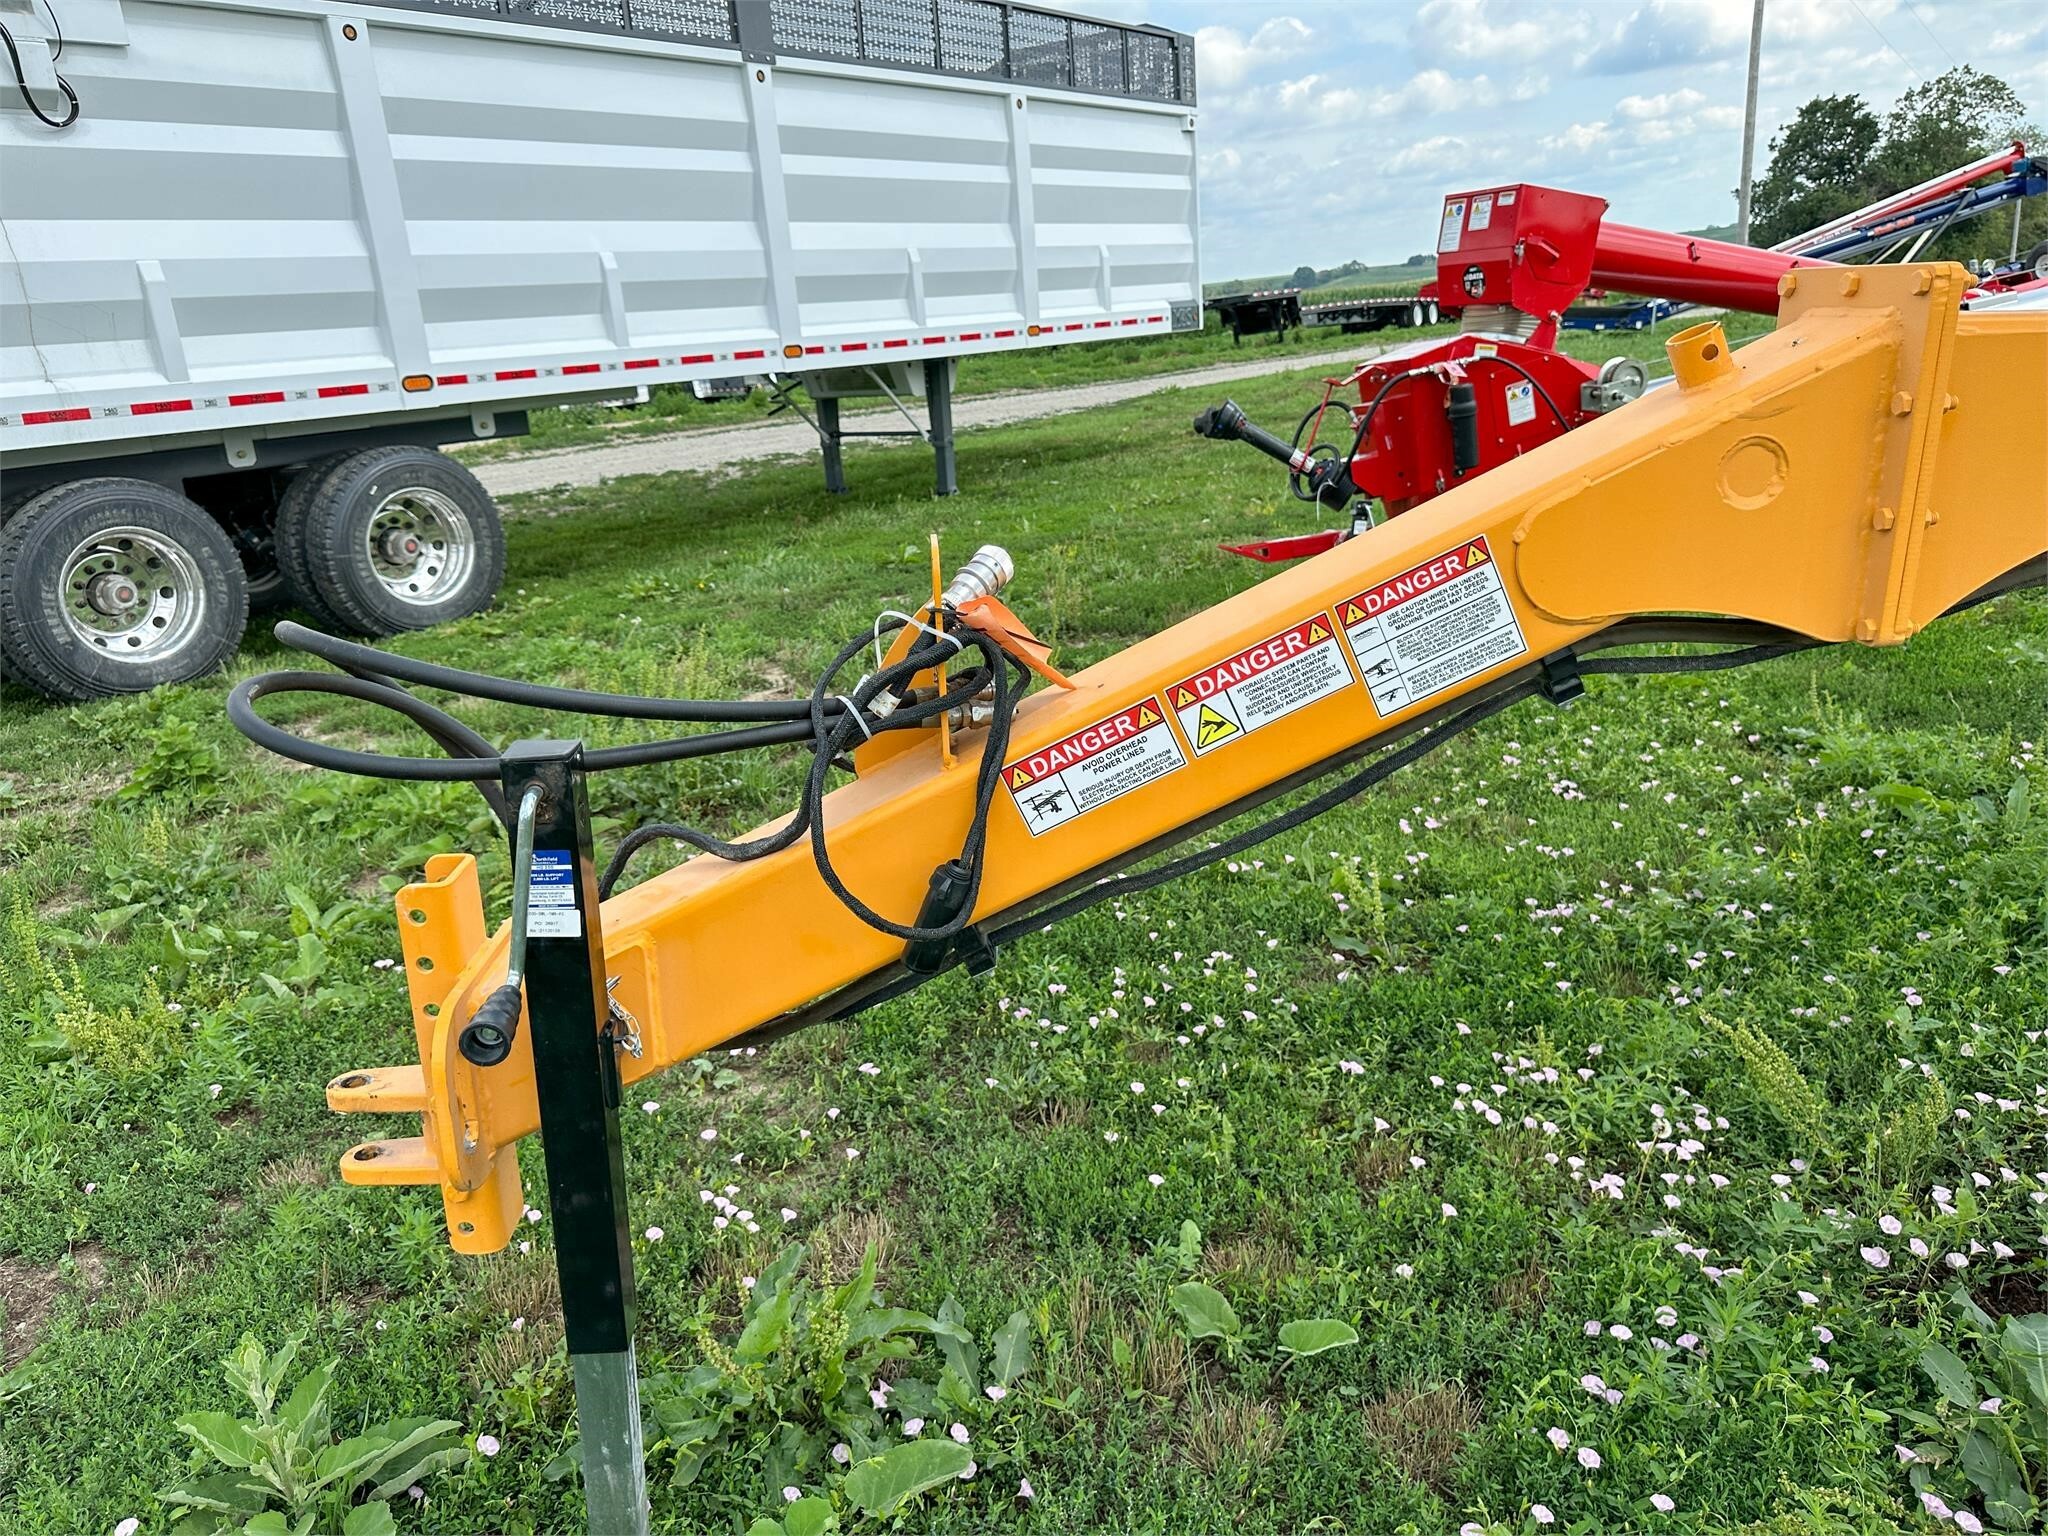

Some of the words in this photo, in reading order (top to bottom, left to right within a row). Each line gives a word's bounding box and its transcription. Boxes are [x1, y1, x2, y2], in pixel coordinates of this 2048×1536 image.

[1364, 554, 1462, 612] DANGER
[1386, 610, 1400, 620] USE
[1400, 597, 1428, 614] CAUTION
[1429, 587, 1448, 600] WHEN
[1448, 582, 1458, 591] ON
[1459, 570, 1484, 586] UNEVEN
[1395, 614, 1423, 631] MACHINE
[1424, 602, 1449, 617] TIPPING
[1449, 595, 1463, 605] MAY
[1463, 583, 1488, 598] OCCUR.
[1387, 610, 1414, 627] GROUND
[1415, 605, 1425, 614] OR
[1425, 595, 1446, 609] GOING
[1446, 588, 1463, 599] FAST
[1396, 633, 1413, 644] BLOCK
[1430, 615, 1452, 628] SUPPORT
[1453, 606, 1471, 617] RAISED
[1471, 595, 1493, 608] MACHINE
[1397, 640, 1422, 654] CRUSHING
[1423, 631, 1440, 642] INJURY
[1449, 620, 1464, 630] DEATH
[1465, 613, 1479, 622] FROM
[1480, 603, 1500, 615] SUDDEN
[1416, 629, 1433, 640] LIFTED
[1434, 613, 1467, 631] COMPONENTS
[1475, 598, 1498, 612] PREVENT
[1399, 644, 1424, 659] DROPPING
[1433, 625, 1466, 643] INADVERTENT
[1466, 611, 1494, 627] OPERATION
[1409, 644, 1436, 659] CONTROLS
[1436, 637, 1451, 647] WHILE
[1452, 622, 1484, 639] PERFORMING
[1484, 616, 1495, 624] AND
[1417, 643, 1451, 661] MAINTENANCE
[1194, 630, 1305, 696] DANGER
[1237, 674, 1271, 693] HYDRAULIC
[1271, 662, 1295, 677] SYSTEM
[1296, 652, 1315, 665] PARTS
[1316, 645, 1330, 655] AND
[1244, 673, 1286, 697] CONNECTIONS
[1287, 667, 1300, 676] CAN
[1300, 654, 1327, 670] CONTAIN
[1249, 691, 1264, 702] HIGH
[1264, 674, 1300, 694] PRESSURES
[1300, 664, 1321, 677] WHICH
[1407, 669, 1428, 681] BEFORE
[1429, 655, 1457, 671] CHANGING
[1457, 648, 1472, 658] RAKE
[1473, 642, 1485, 651] ARM
[1411, 679, 1430, 690] CLEAR
[1438, 670, 1449, 678] ALL
[1449, 654, 1484, 672] BYSTANDERS
[1484, 648, 1496, 656] AND
[1496, 639, 1515, 650] OTHER
[1411, 681, 1437, 696] POSSIBLE
[1438, 669, 1462, 683] OBJECTS
[1463, 657, 1487, 672] SUBJECT
[1496, 642, 1519, 656] DAMAGE
[1412, 675, 1427, 685] MAKE
[1427, 668, 1442, 677] SURE
[1443, 661, 1457, 670] AREA
[1466, 651, 1478, 659] NEW
[1479, 639, 1504, 653] POSITION
[1245, 692, 1276, 710] SUDDENLY
[1276, 686, 1290, 695] AND
[1290, 664, 1336, 689] UNEXPECTEDLY
[1246, 698, 1279, 717] RELEASED,
[1279, 691, 1292, 701] CAN
[1293, 681, 1313, 695] CAUSE
[1314, 668, 1340, 684] SERIOUS
[1263, 703, 1284, 716] INJURY
[1284, 691, 1308, 705] AND/OR
[1028, 713, 1136, 777] DANGER
[1081, 756, 1104, 771] AVOID
[1105, 735, 1148, 760] OVERHEAD
[1093, 757, 1121, 775] POWER
[1122, 746, 1145, 761] LINES
[1078, 780, 1103, 796] SERIOUS
[1103, 770, 1124, 783] INJURY
[1134, 757, 1153, 769] DEATH
[1154, 748, 1171, 759] FROM
[1078, 794, 1104, 809] WITHOUT
[1105, 776, 1142, 796] CONTACTING
[1142, 765, 1164, 779] POWER
[1164, 757, 1181, 768] LINES
[1081, 781, 1116, 801] ELECTRICAL
[1117, 772, 1137, 784] SHOCK
[1138, 765, 1150, 774] CAN
[1151, 755, 1172, 768] OCCUR
